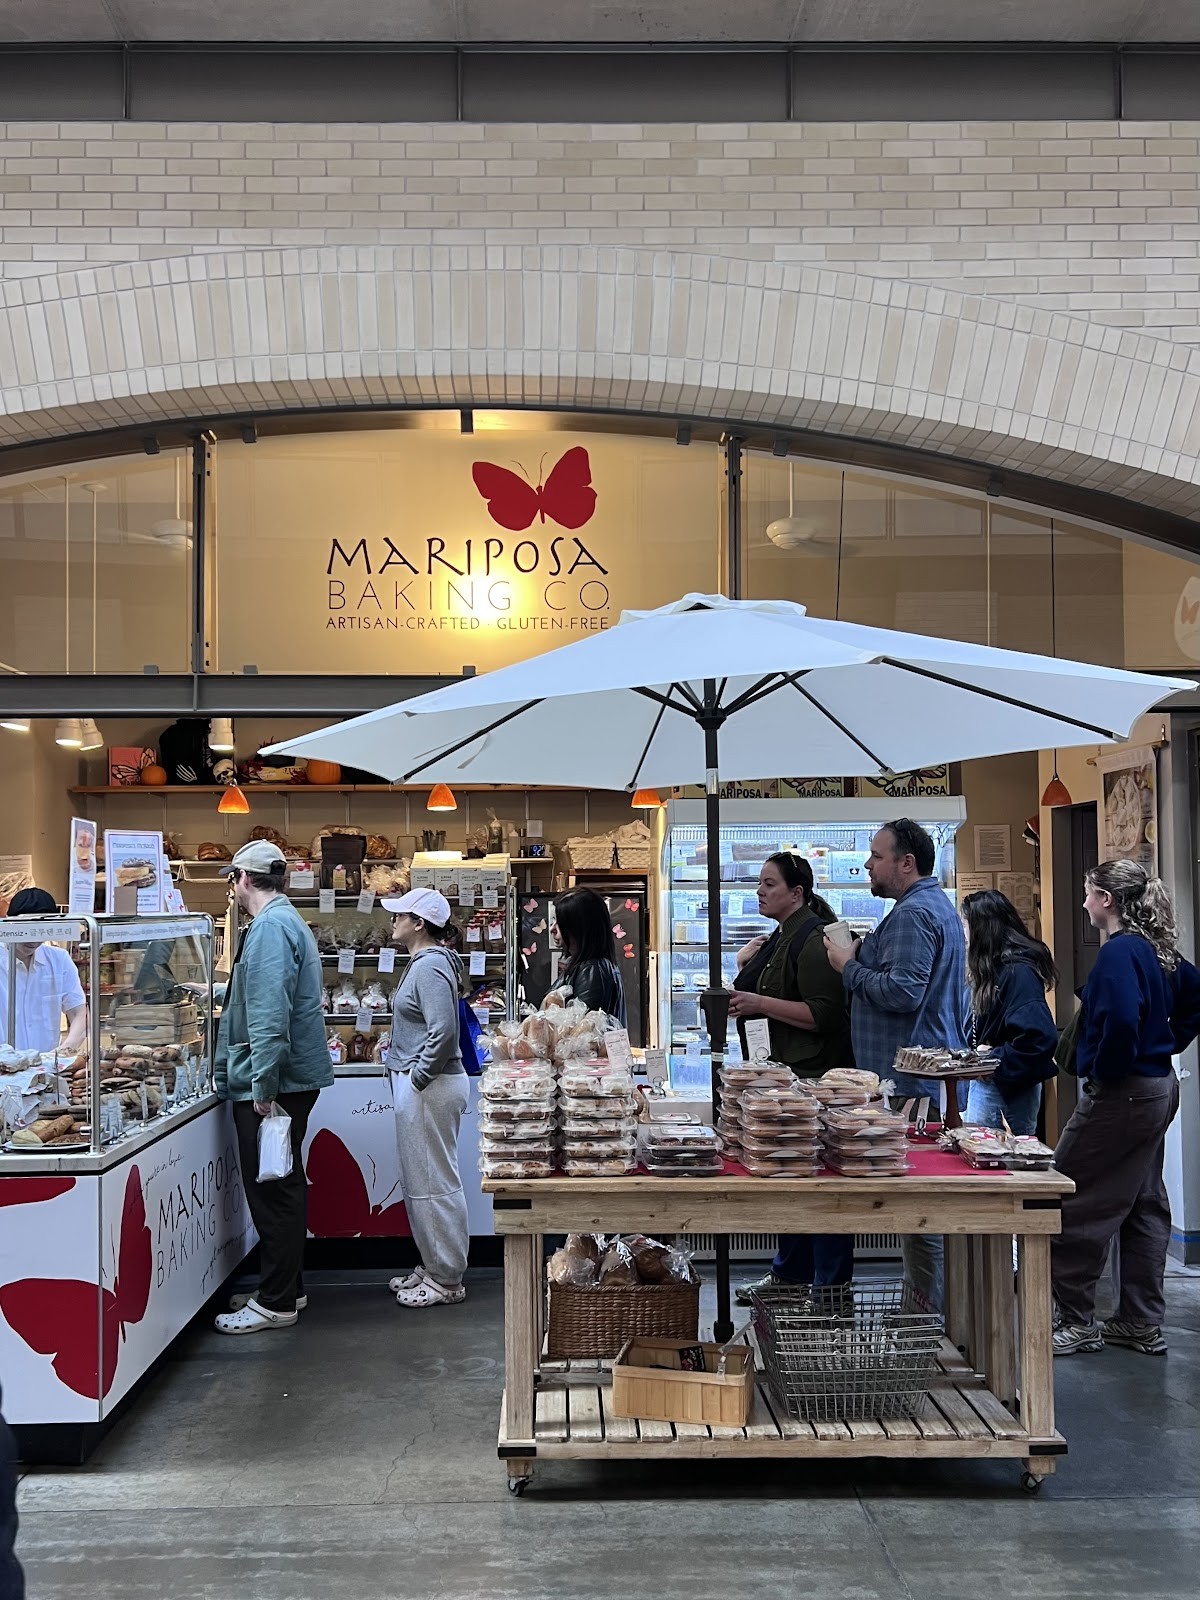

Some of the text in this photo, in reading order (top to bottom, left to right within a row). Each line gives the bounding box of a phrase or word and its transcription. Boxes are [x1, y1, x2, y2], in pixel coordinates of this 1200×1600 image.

[326, 537, 609, 576] MARIPOSA
[328, 580, 610, 611] BAKING CO.
[326, 616, 609, 630] ARTISAN-CRAFTED GLUTEN-FREE
[720, 788, 762, 799] ARIPOSA
[799, 788, 842, 798] MARIPOSA
[892, 785, 947, 798] MARIPOSA
[351, 1099, 394, 1116] artisa
[157, 1143, 240, 1245] MARIPOSA
[156, 1203, 216, 1289] BAKING
